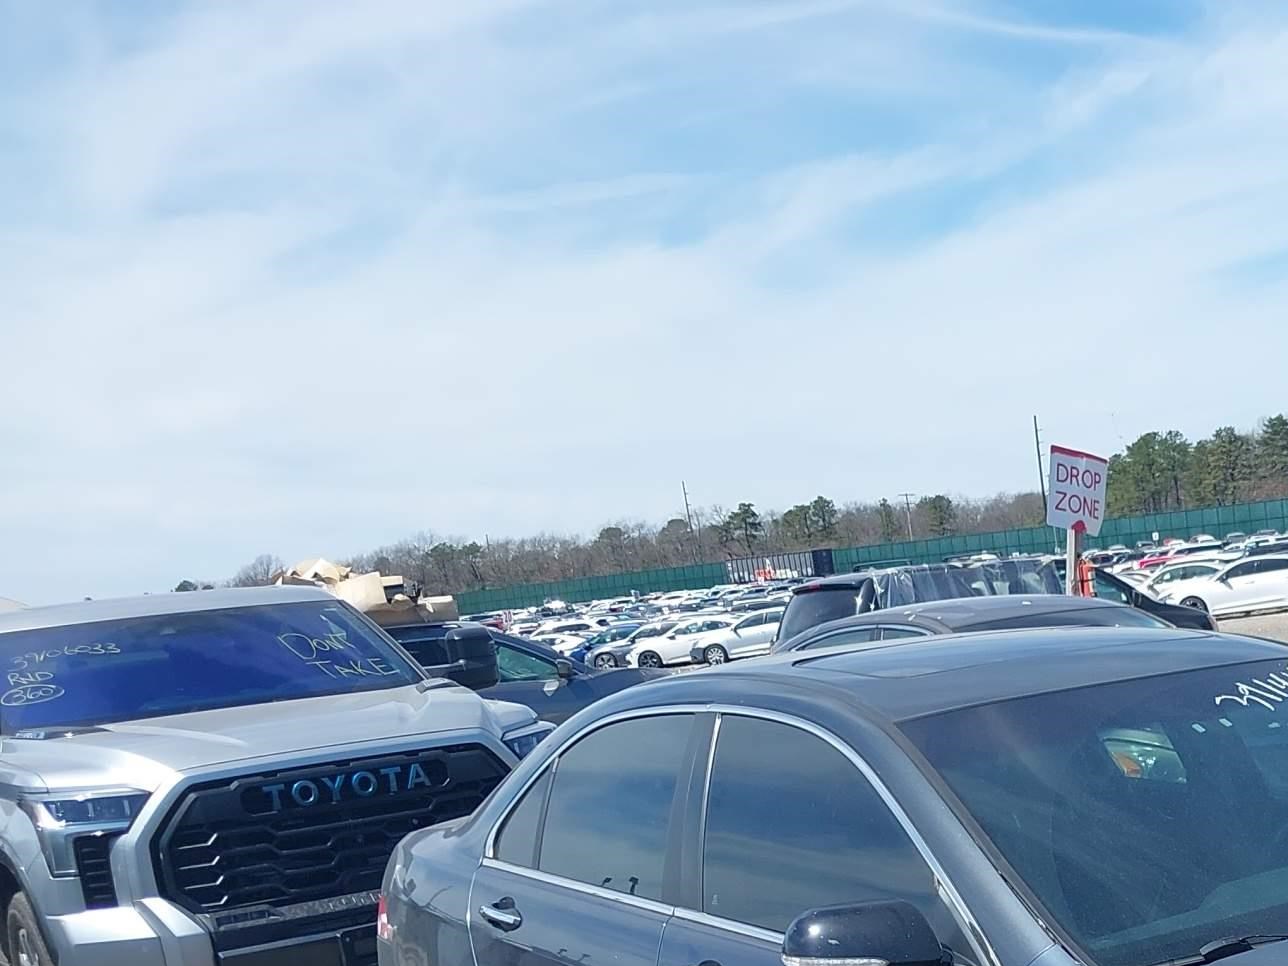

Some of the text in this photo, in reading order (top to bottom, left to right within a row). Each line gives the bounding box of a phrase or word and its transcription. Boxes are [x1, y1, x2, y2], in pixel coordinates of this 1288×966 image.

[1056, 462, 1102, 491] DROP
[1055, 490, 1101, 520] ZONE
[305, 657, 401, 679] TAKE
[12, 686, 54, 704] 360
[262, 762, 432, 811] TOYOTA
